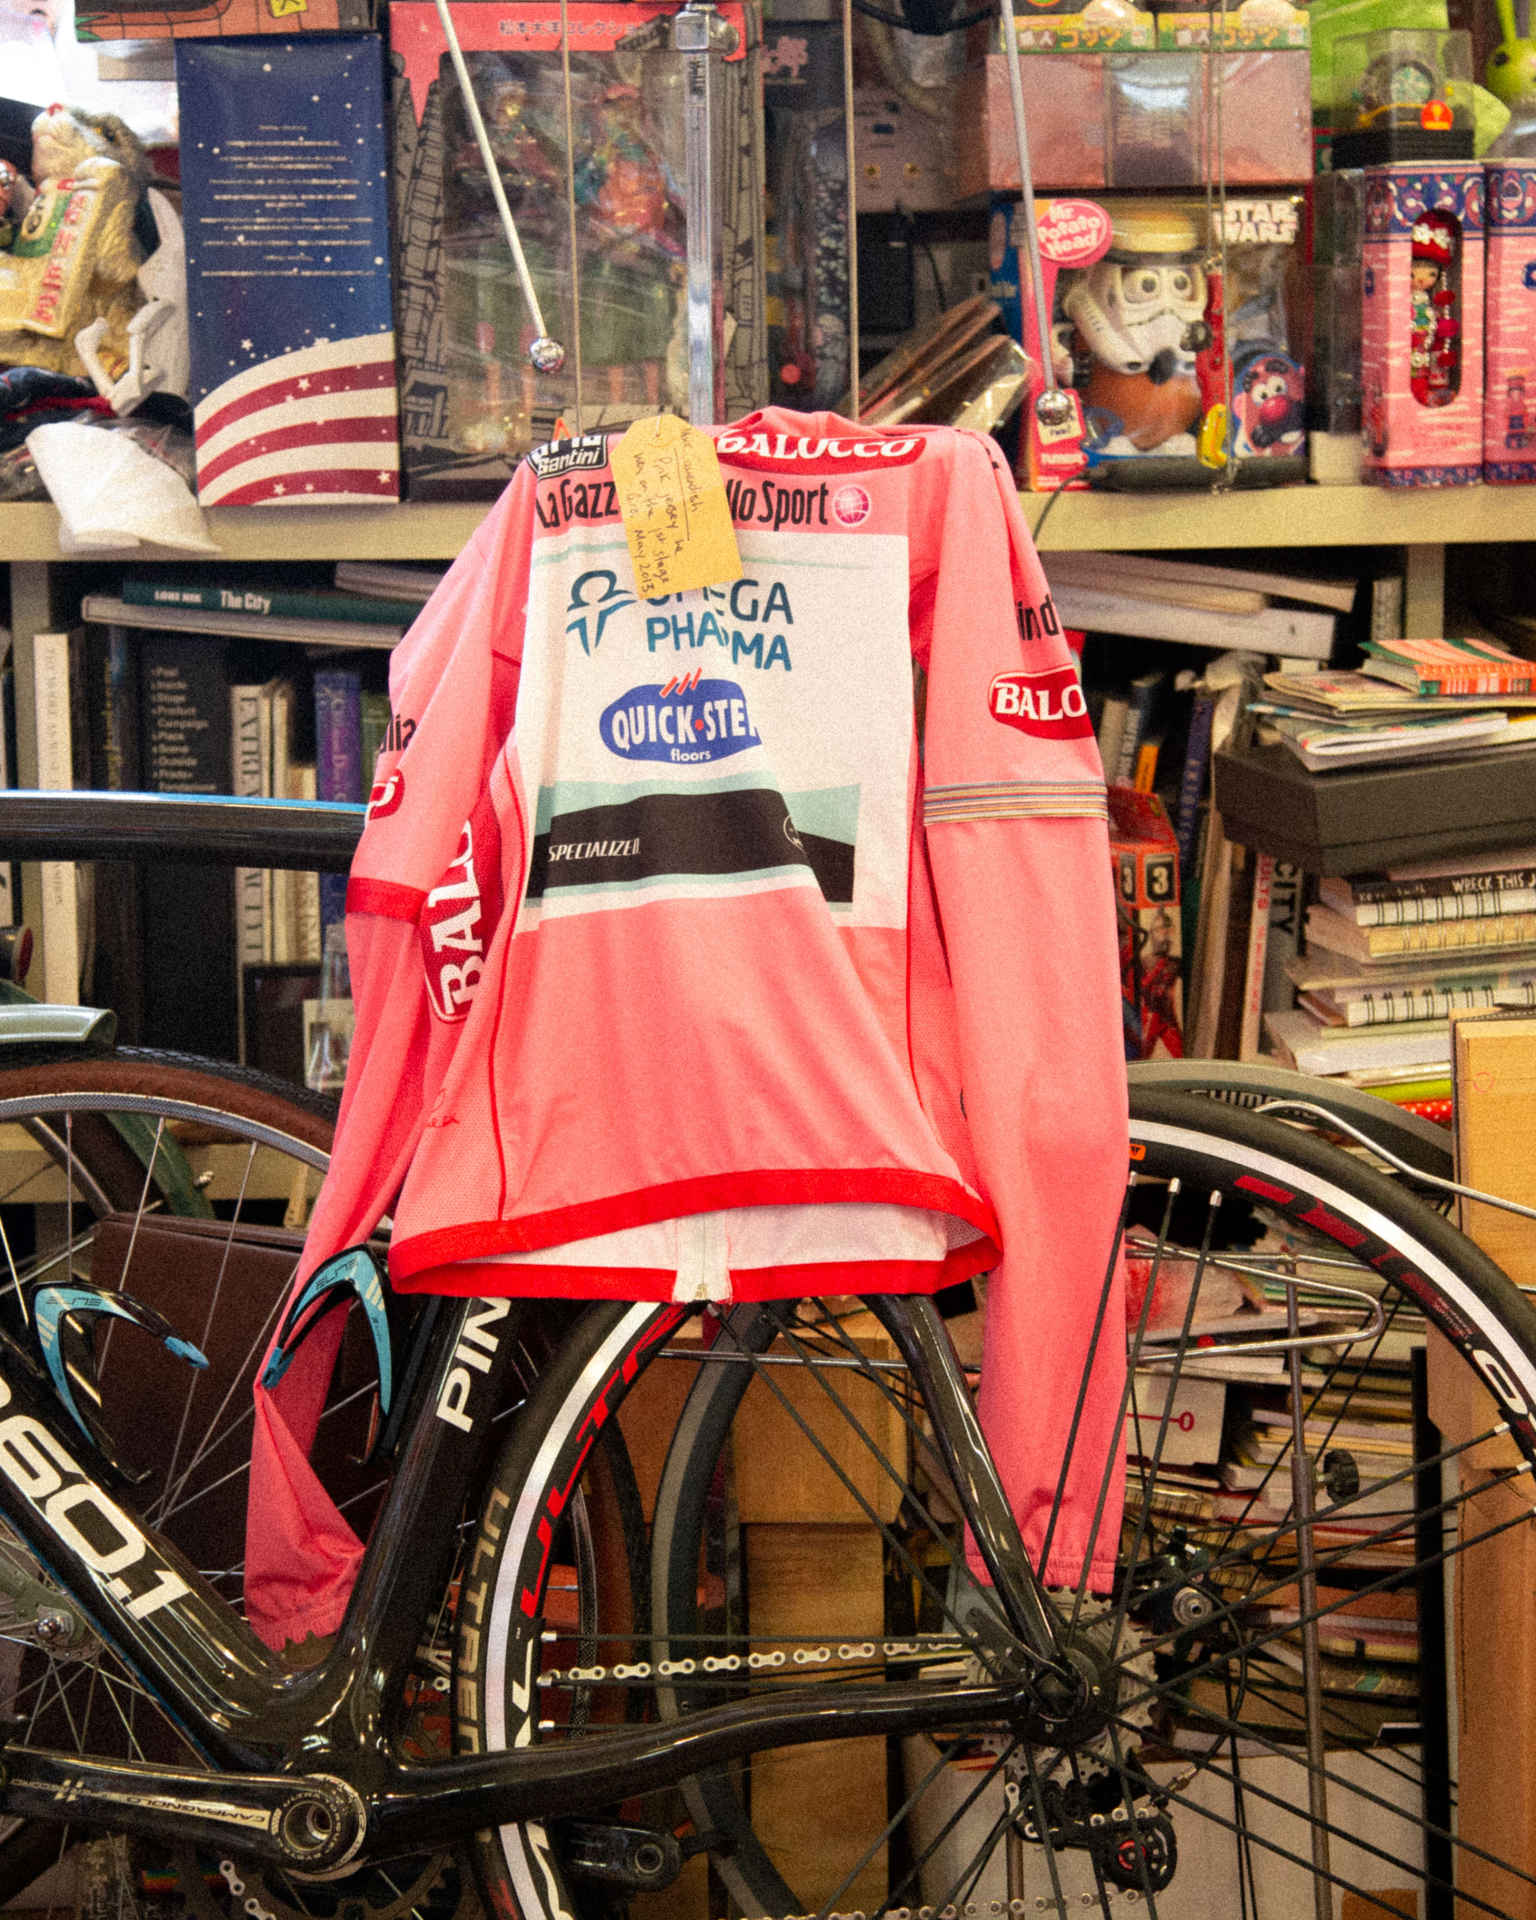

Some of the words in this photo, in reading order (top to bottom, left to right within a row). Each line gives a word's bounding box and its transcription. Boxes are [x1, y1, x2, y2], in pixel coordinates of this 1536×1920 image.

[1223, 199, 1292, 222] STAR
[1037, 216, 1101, 243] Potato
[1212, 212, 1297, 244] WARS
[1045, 229, 1098, 258] Head
[757, 480, 830, 531] Sport
[633, 528, 647, 560] May
[638, 562, 656, 593] 2013
[651, 549, 671, 584] stage
[220, 590, 243, 609] The
[243, 592, 272, 616] City
[645, 611, 793, 672] PHAMA
[995, 682, 1088, 721] BALO
[670, 748, 712, 762] floors
[1151, 866, 1170, 896] 3
[1272, 855, 1298, 935] CITY
[1451, 875, 1494, 894] WRECK
[1495, 870, 1525, 891] THIS
[130, 1795, 268, 1824] CAMPAGNOLO
